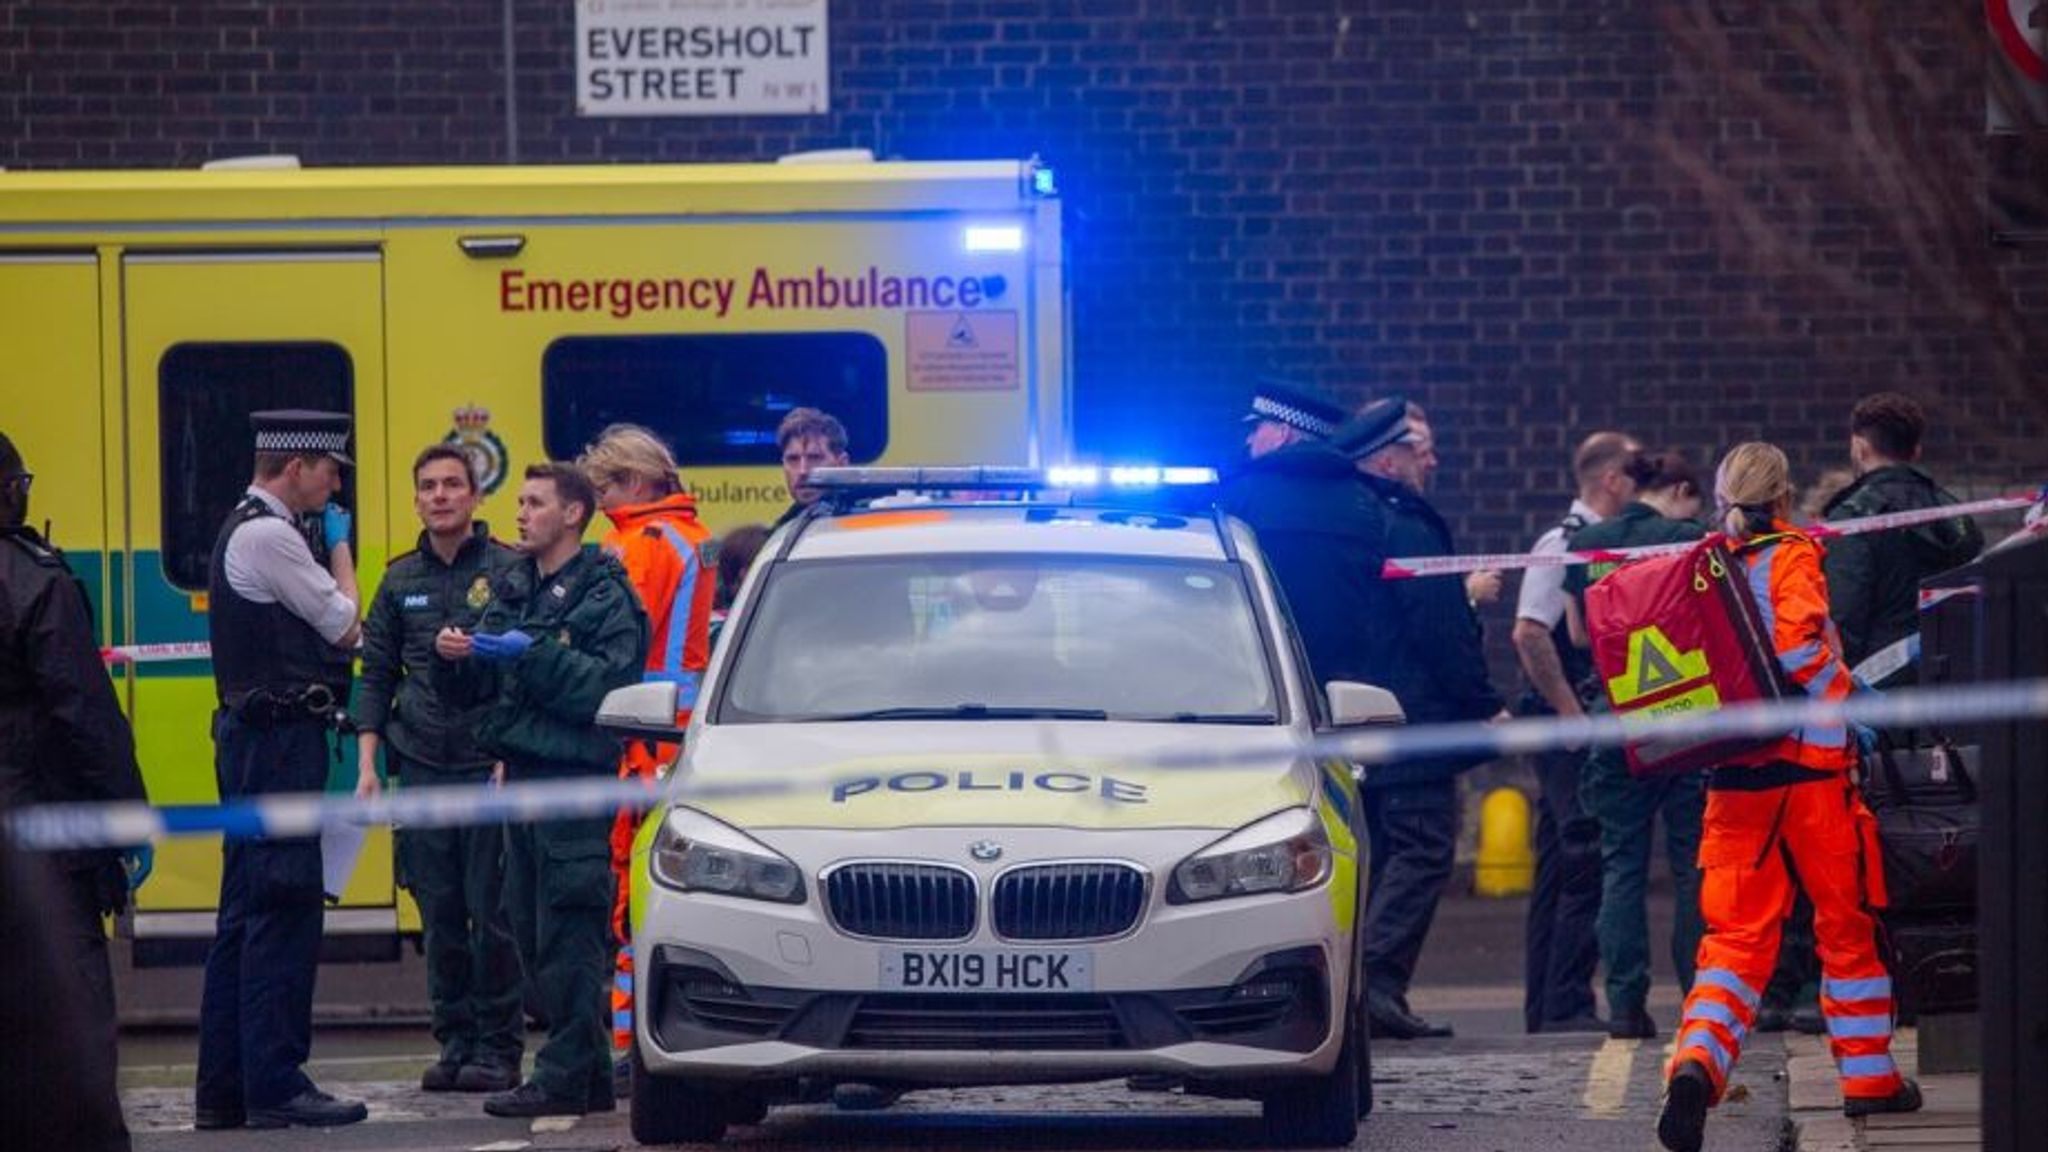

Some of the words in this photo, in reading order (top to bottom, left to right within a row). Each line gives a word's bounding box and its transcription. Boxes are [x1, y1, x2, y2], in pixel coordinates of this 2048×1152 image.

[587, 27, 814, 59] EVERSHOLT
[589, 68, 743, 100] STREET
[500, 269, 735, 319] Emergency
[747, 266, 983, 309] Ambulance
[832, 771, 1148, 802] POLICE
[903, 953, 985, 987] BX19
[997, 954, 1070, 988] HCK
